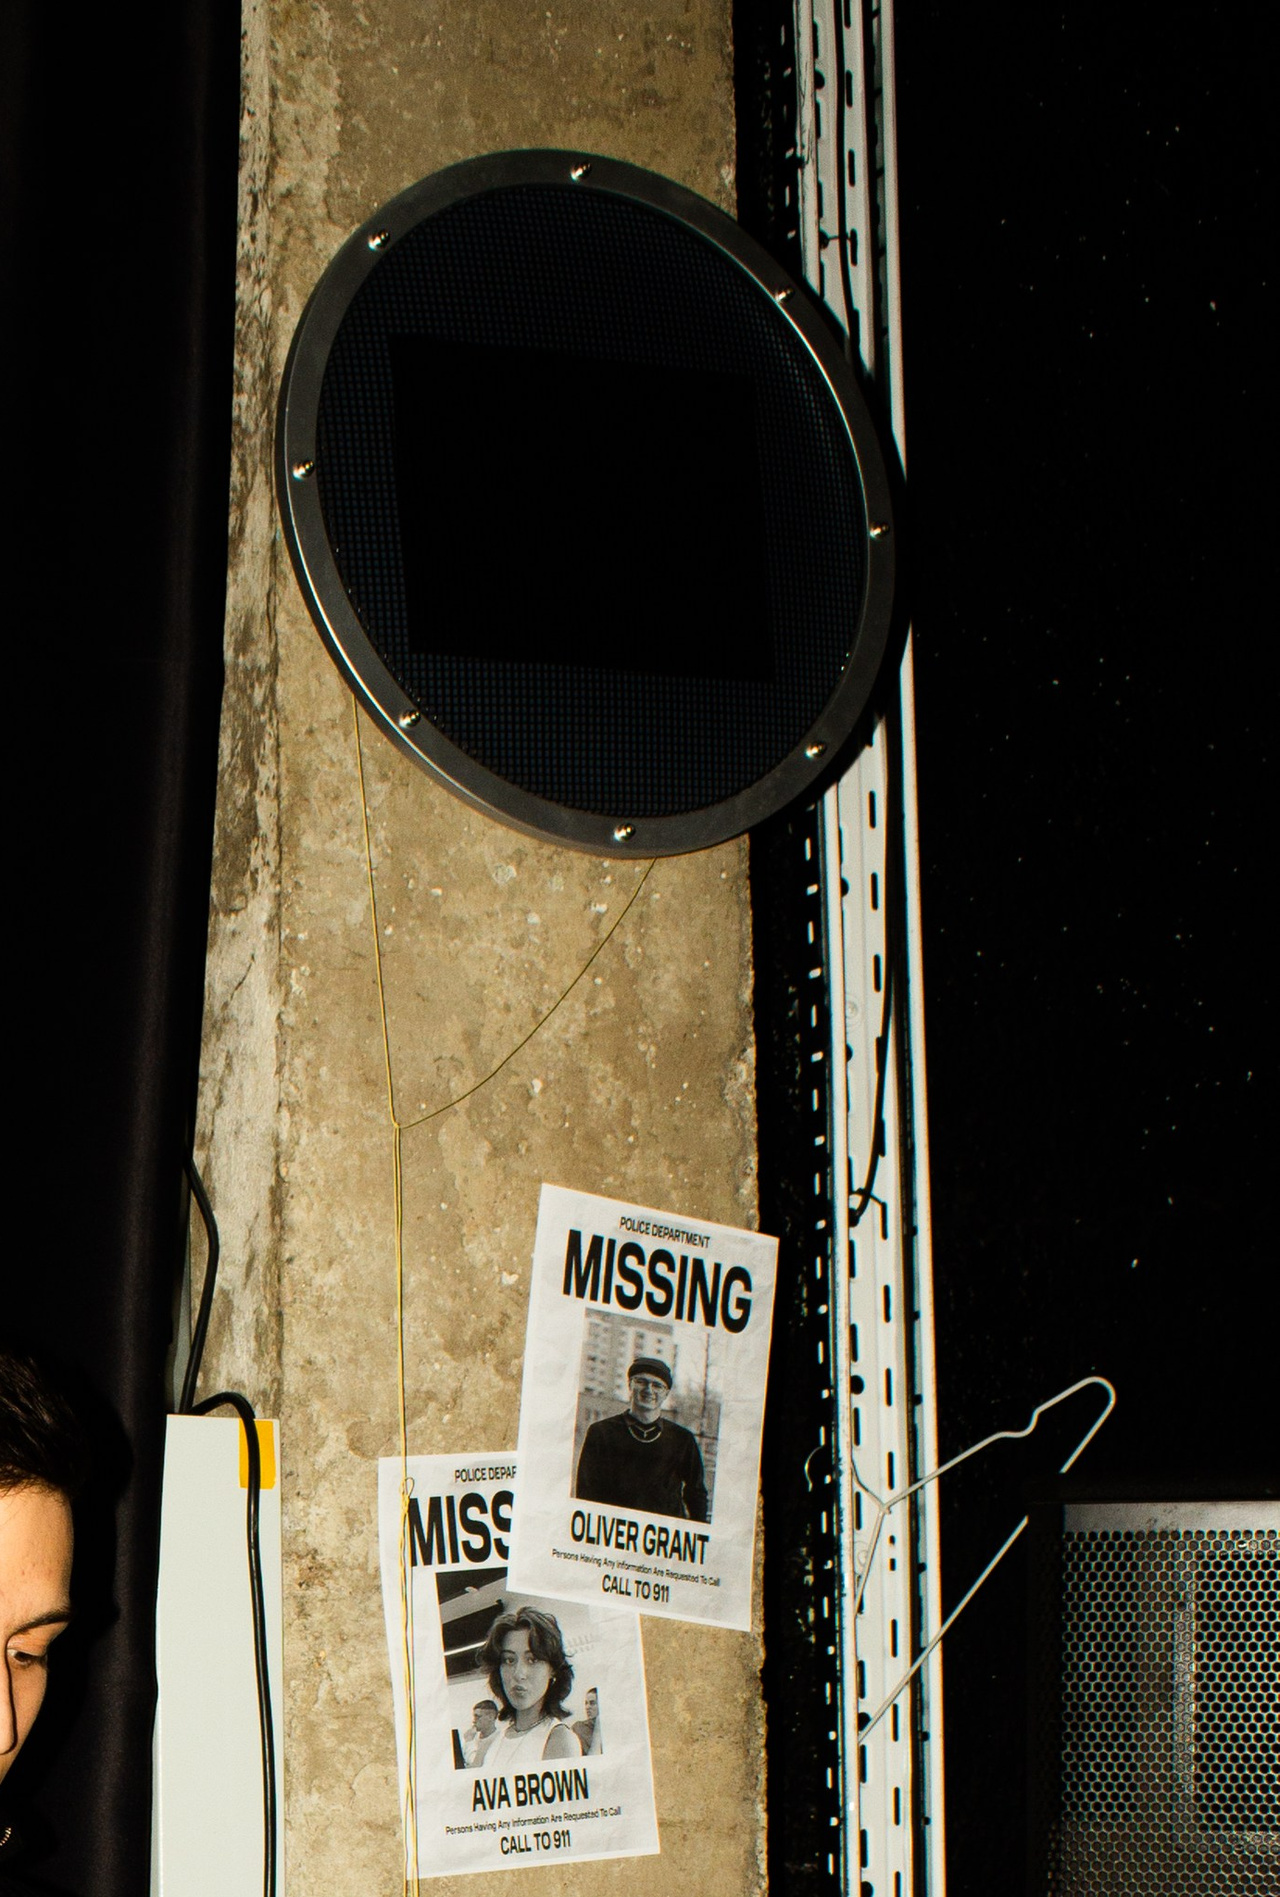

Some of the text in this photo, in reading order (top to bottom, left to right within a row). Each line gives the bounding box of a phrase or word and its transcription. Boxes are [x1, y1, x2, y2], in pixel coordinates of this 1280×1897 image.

[619, 1216, 711, 1248] POLICE DEPARTMENT
[563, 1228, 752, 1334] MISSING
[454, 1467, 487, 1483] POLICE
[407, 1489, 515, 1567] MISS
[570, 1510, 710, 1565] OLIVER GRANT
[551, 1548, 721, 1587] Persons Having Any Information Are Requested To Call
[601, 1573, 670, 1603] CALL TO 911
[471, 1767, 590, 1812] AVA BROWN
[445, 1805, 622, 1836] Persons Having Any Information Are Requested To Call
[500, 1829, 571, 1856] CALL TO 911
